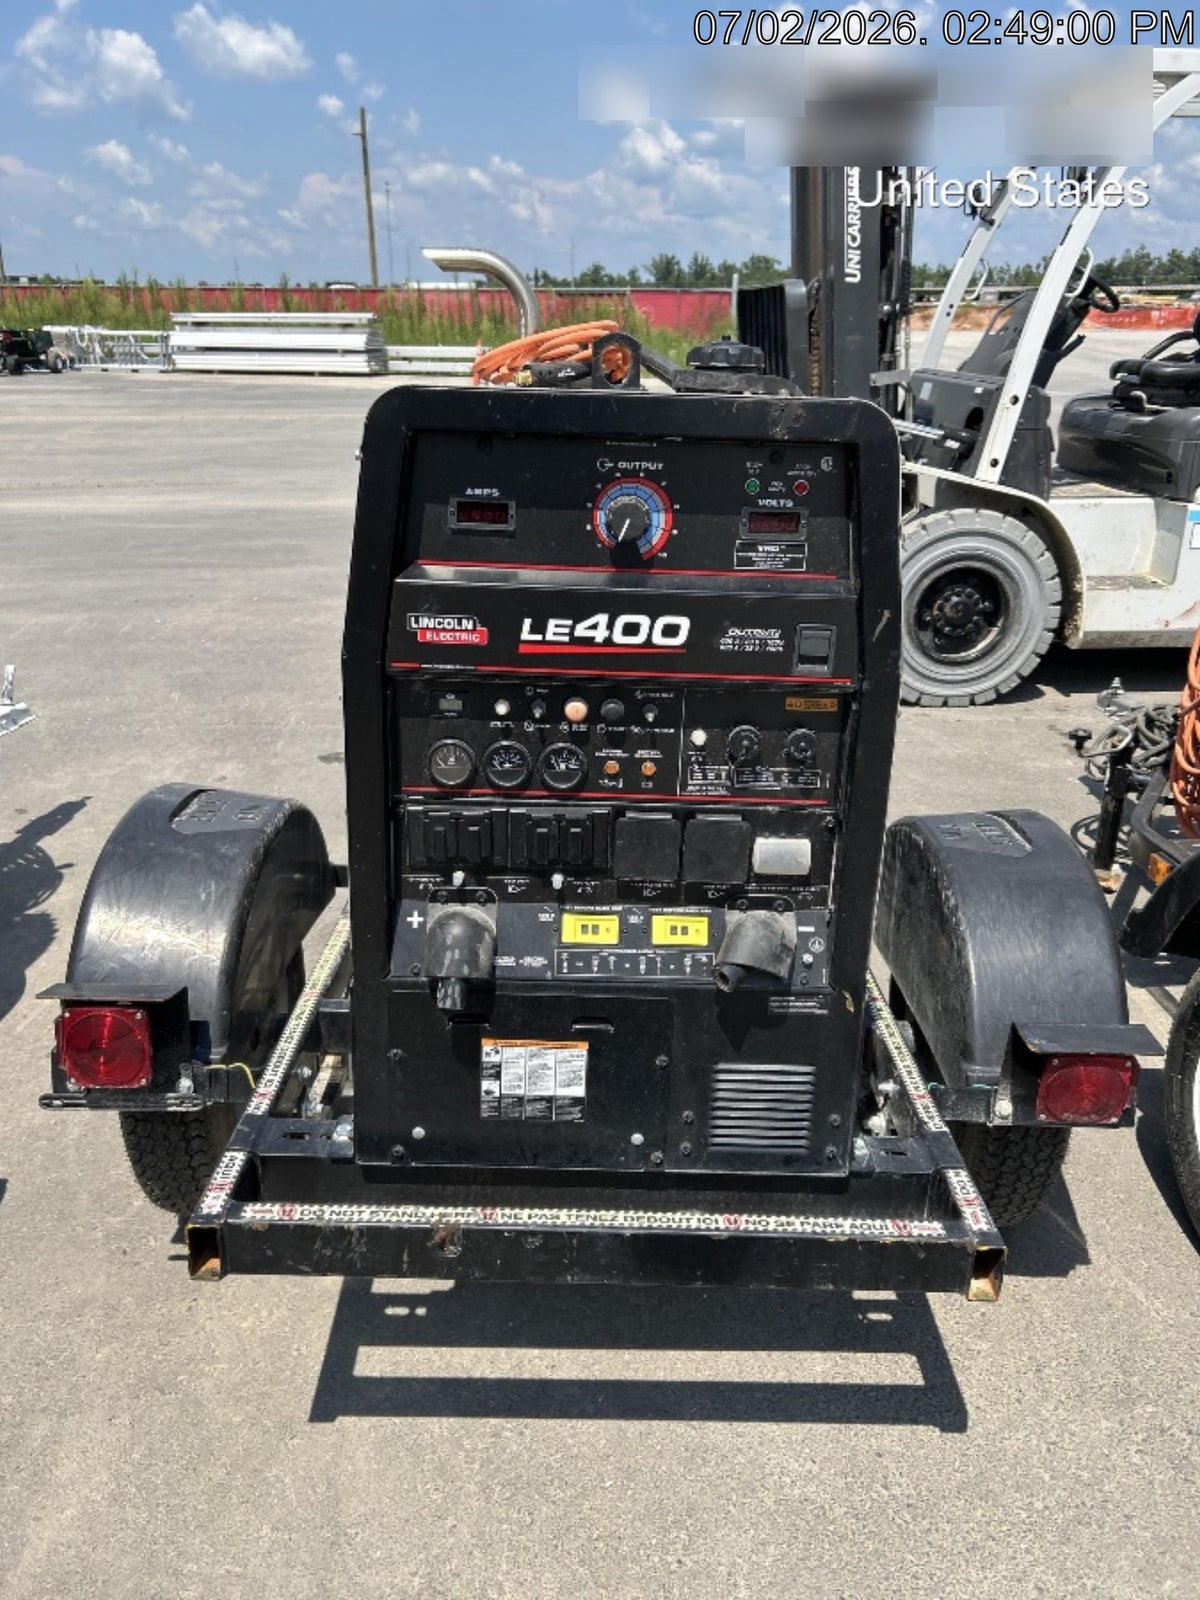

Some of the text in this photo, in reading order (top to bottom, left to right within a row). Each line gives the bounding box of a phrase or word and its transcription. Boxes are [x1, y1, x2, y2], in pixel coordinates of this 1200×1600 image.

[618, 462, 664, 470] OUTPUT
[465, 488, 500, 497] AMPS
[758, 499, 794, 508] VOLTS
[410, 616, 474, 630] LINCOLN
[520, 612, 691, 646] LE400
[426, 630, 481, 642] ELECTRIC
[329, 1208, 367, 1218] NOT
